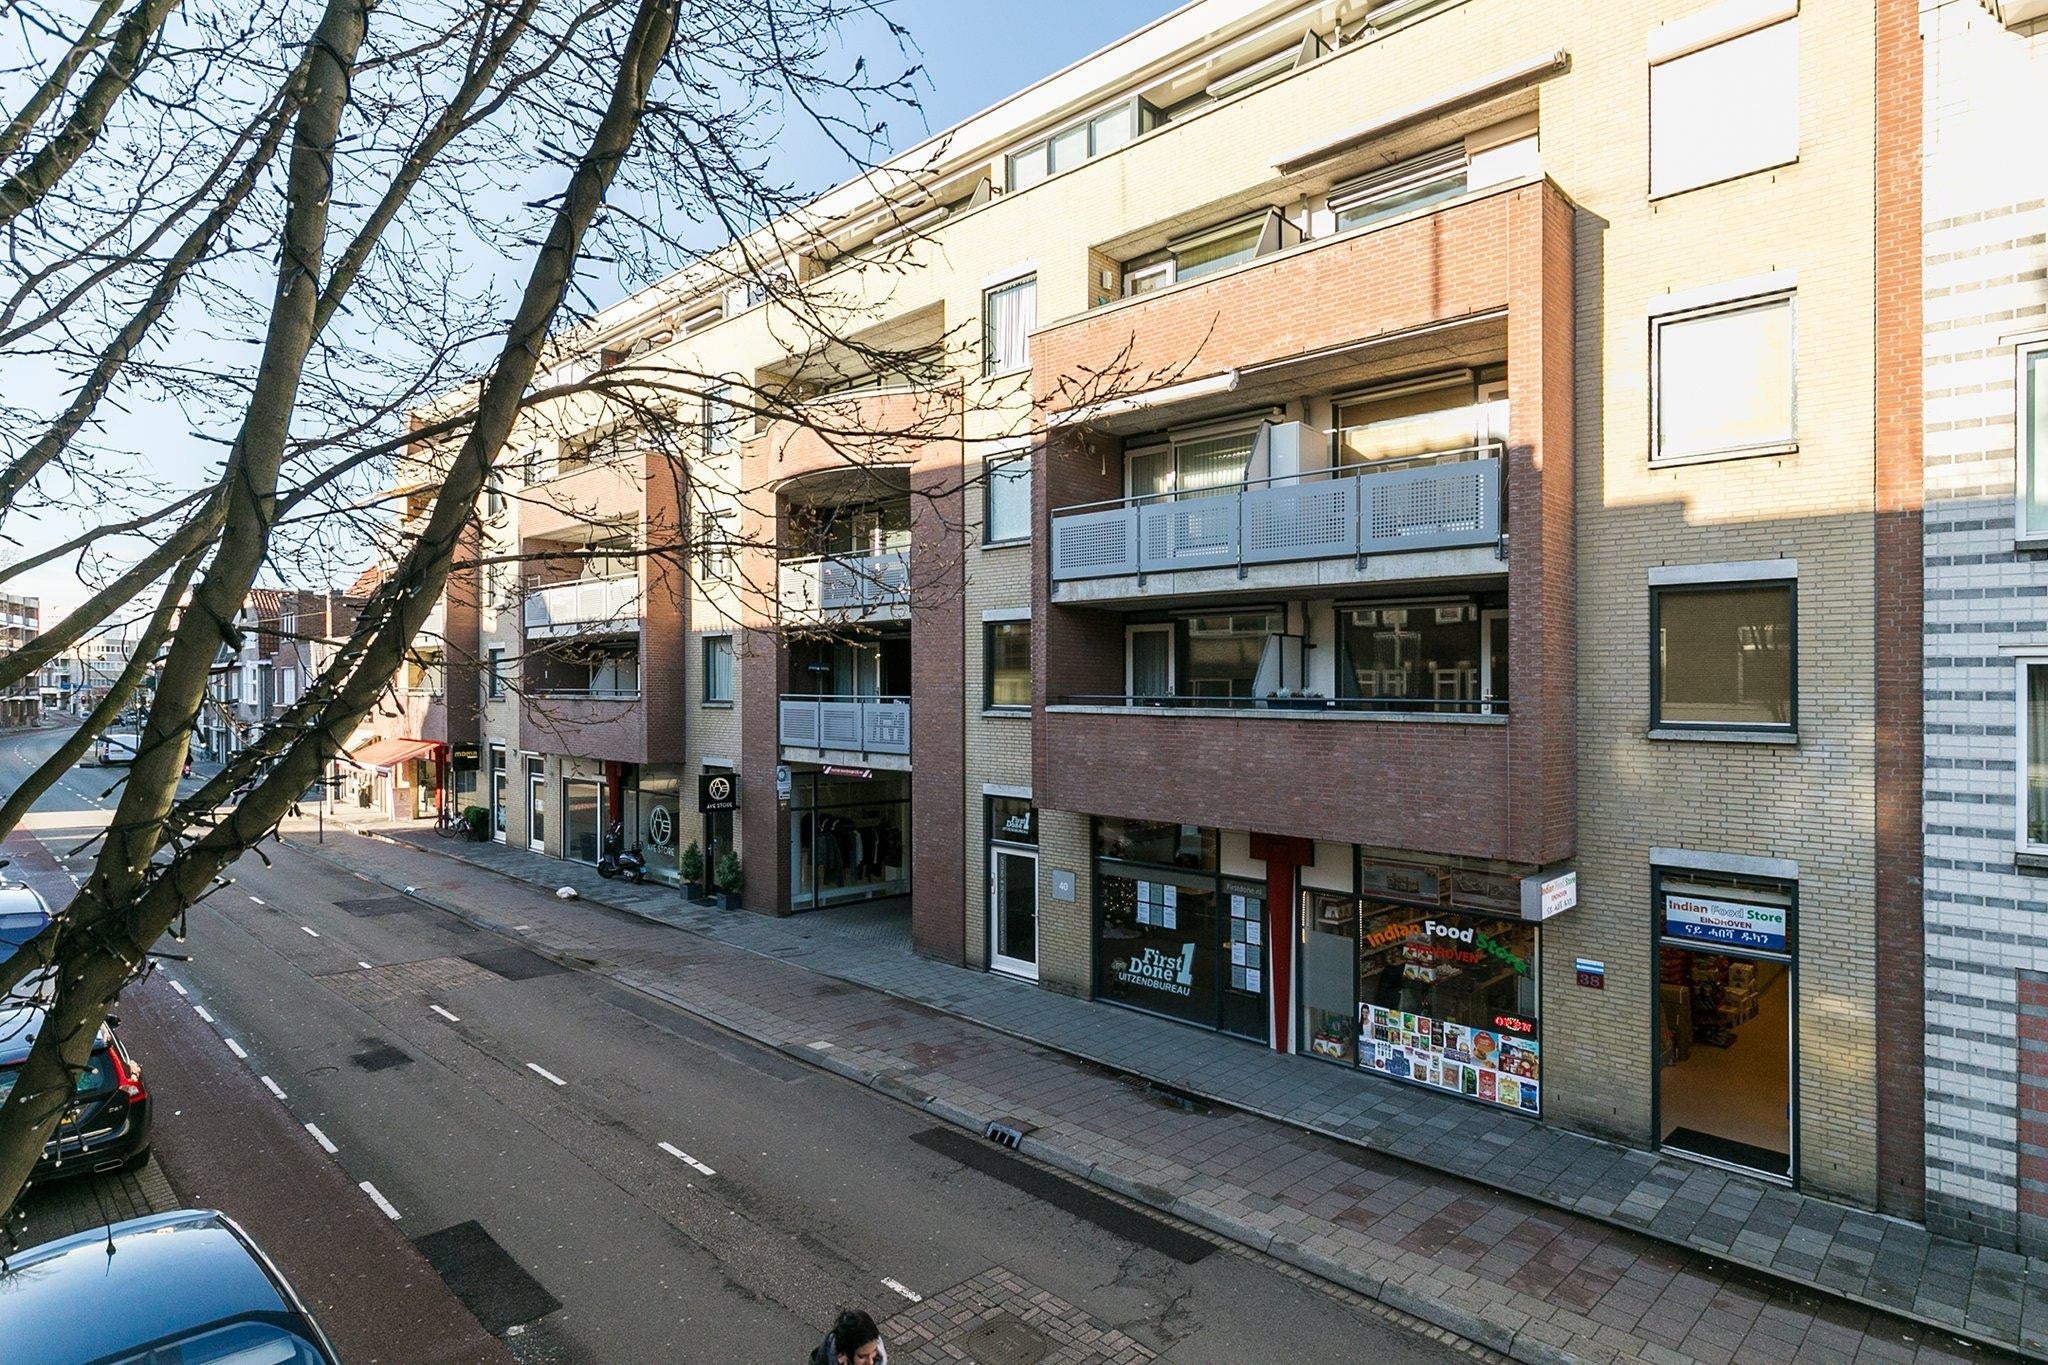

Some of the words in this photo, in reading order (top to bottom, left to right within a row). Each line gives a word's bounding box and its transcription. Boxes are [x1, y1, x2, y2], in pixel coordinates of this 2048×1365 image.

[1058, 882, 1069, 891] 40
[1668, 900, 1708, 914] Indian
[1710, 904, 1745, 919] Food
[1746, 909, 1783, 924] Store
[1700, 916, 1753, 930] EINDHOVEN
[1366, 922, 1421, 949] Indian
[1424, 920, 1474, 944] Food
[1475, 931, 1529, 974] Store
[1128, 956, 1175, 982] Done
[1142, 947, 1183, 972] First
[1118, 971, 1192, 997] UITZENDBUREAU
[1580, 973, 1601, 987] 38
[1495, 1015, 1533, 1033] OPEN
